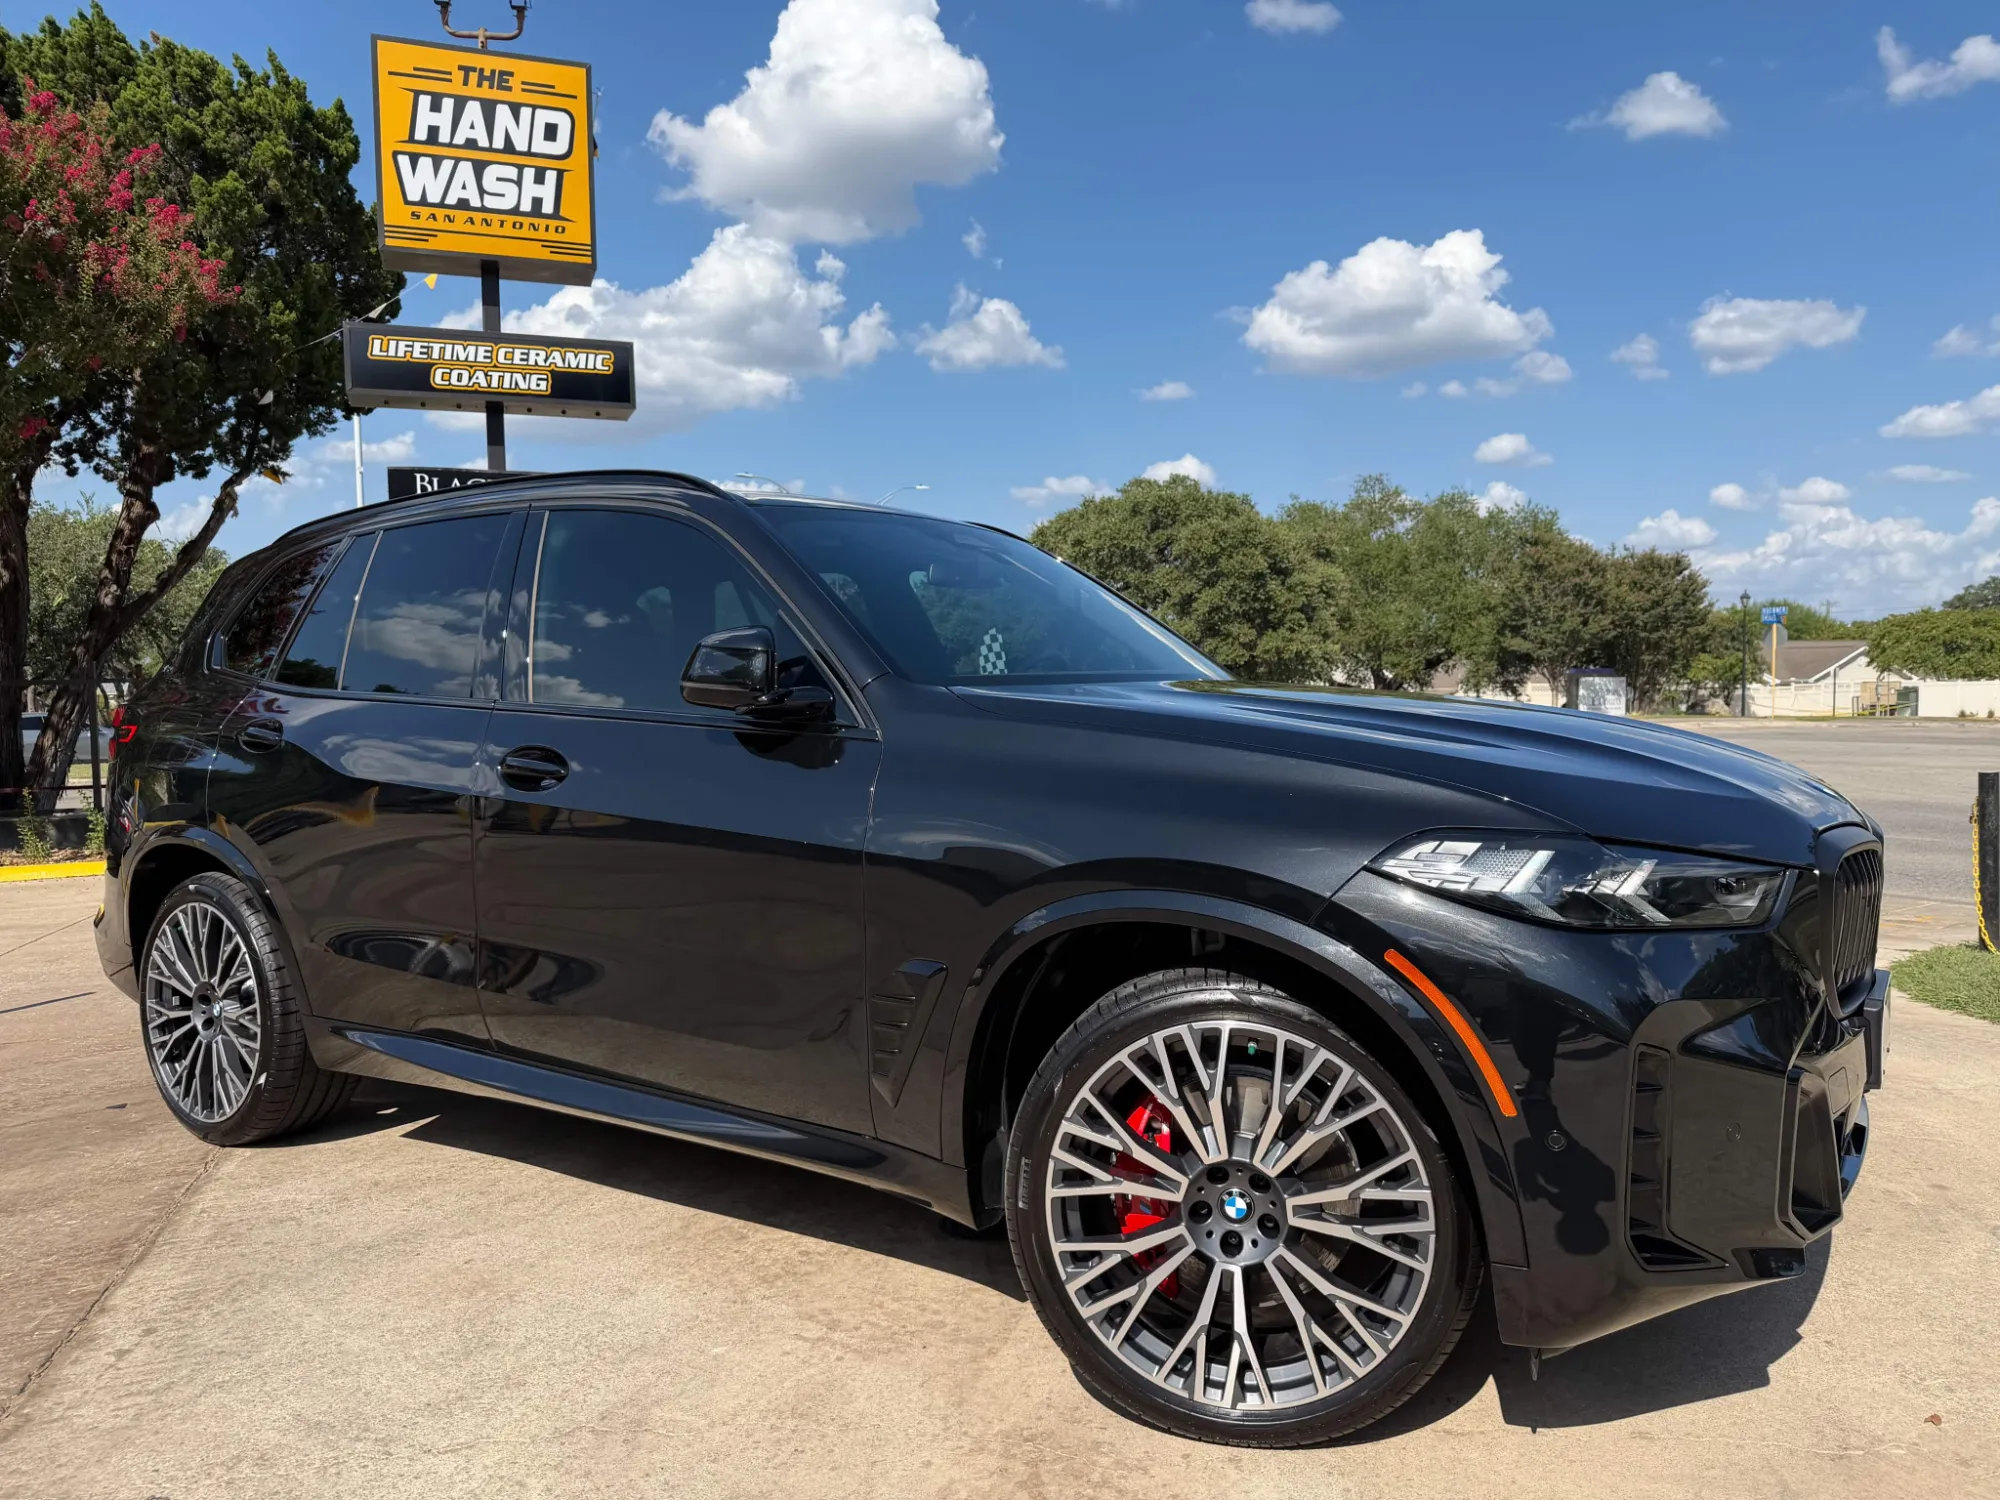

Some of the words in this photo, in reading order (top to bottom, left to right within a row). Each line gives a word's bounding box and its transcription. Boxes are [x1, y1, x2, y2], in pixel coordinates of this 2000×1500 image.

[457, 64, 515, 92] THE
[413, 94, 572, 156] HAND
[396, 153, 558, 215] WASH
[410, 210, 456, 224] SAN
[463, 216, 567, 235] ANTONIO
[371, 338, 492, 364] LIFETIME
[497, 347, 611, 371] CERAMIC
[433, 368, 549, 392] COATING
[413, 472, 493, 495] BLA
